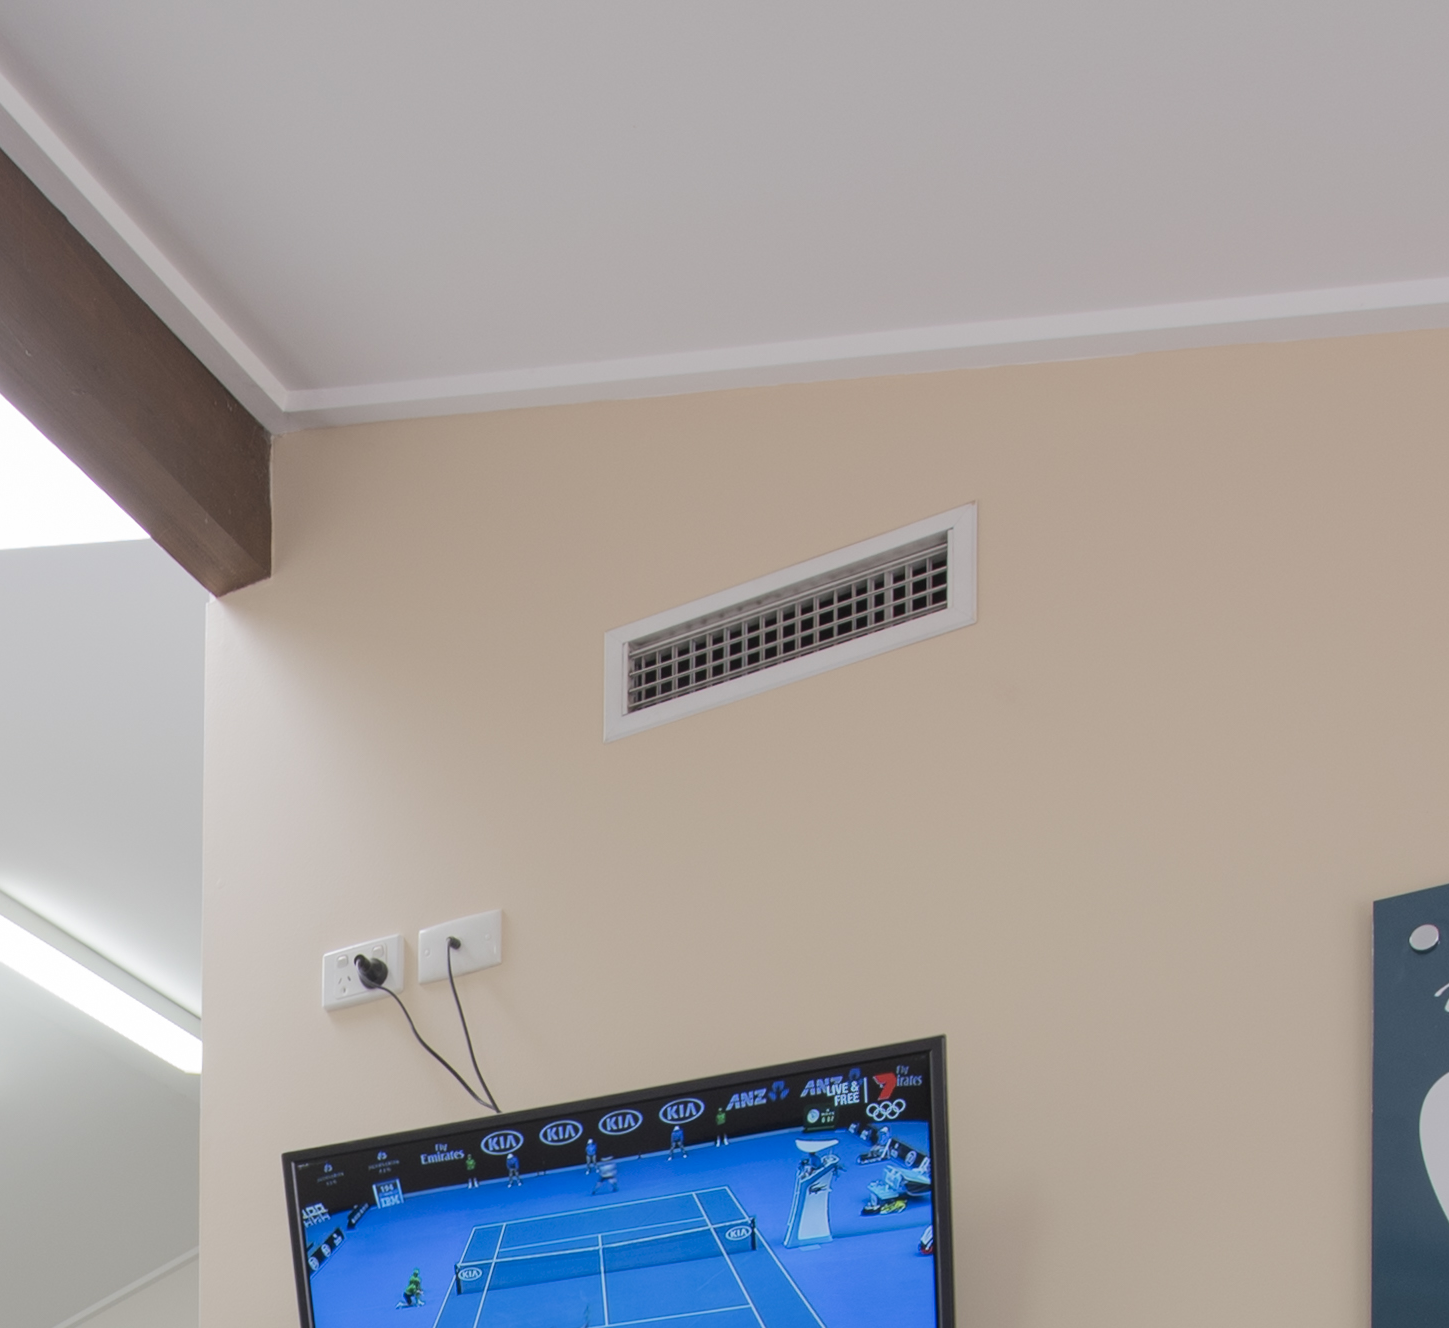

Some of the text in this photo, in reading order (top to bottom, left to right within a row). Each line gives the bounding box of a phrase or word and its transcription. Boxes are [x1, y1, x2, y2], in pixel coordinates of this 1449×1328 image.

[826, 1080, 860, 1096] LIVE &
[896, 1074, 923, 1088] irates
[725, 1088, 767, 1111] ANZ
[834, 1092, 861, 1107] FREE
[666, 1102, 697, 1119] KIA
[606, 1114, 636, 1131] KIA
[546, 1125, 576, 1141] KIA
[487, 1135, 517, 1151] KIA
[420, 1149, 465, 1165] Emirates
